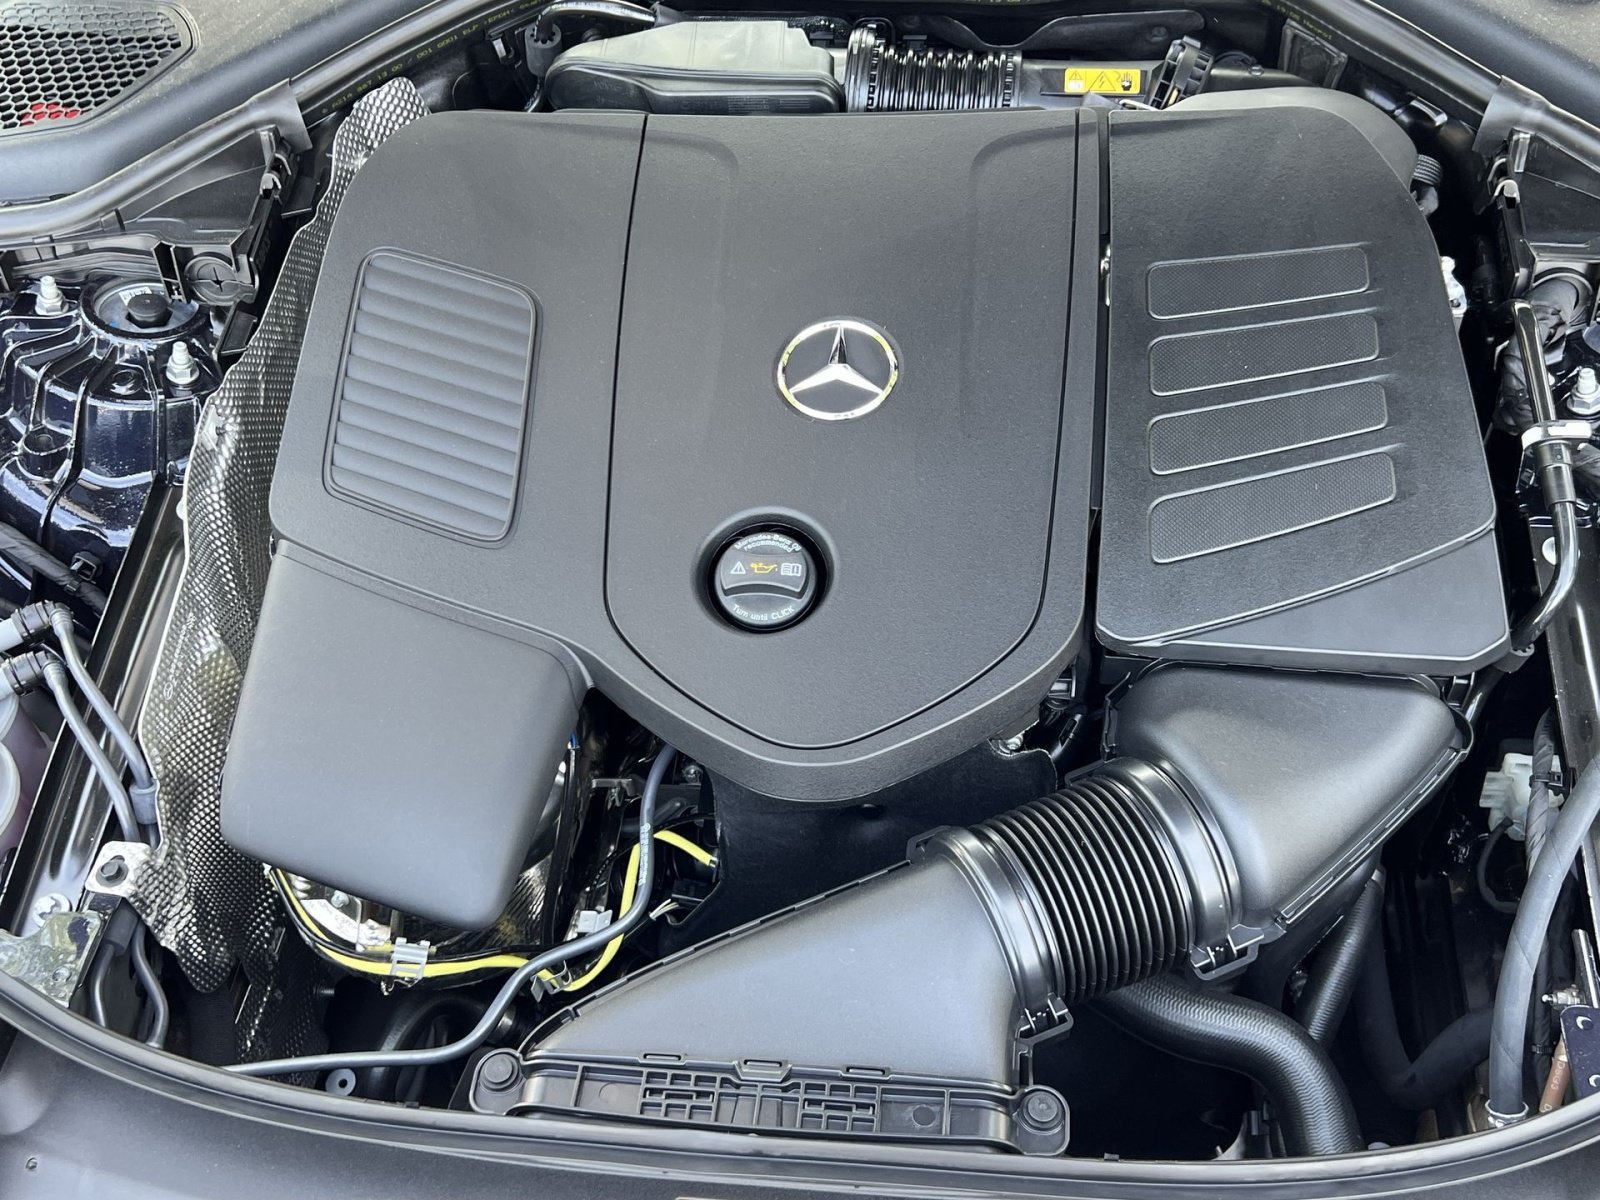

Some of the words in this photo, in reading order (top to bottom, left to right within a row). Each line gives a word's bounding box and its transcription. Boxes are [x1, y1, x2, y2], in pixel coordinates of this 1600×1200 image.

[734, 534, 792, 550] Mercedes-Benz
[743, 540, 793, 553] recommended
[732, 604, 749, 619] Turn
[750, 612, 769, 621] until
[771, 605, 795, 620] CLICK
